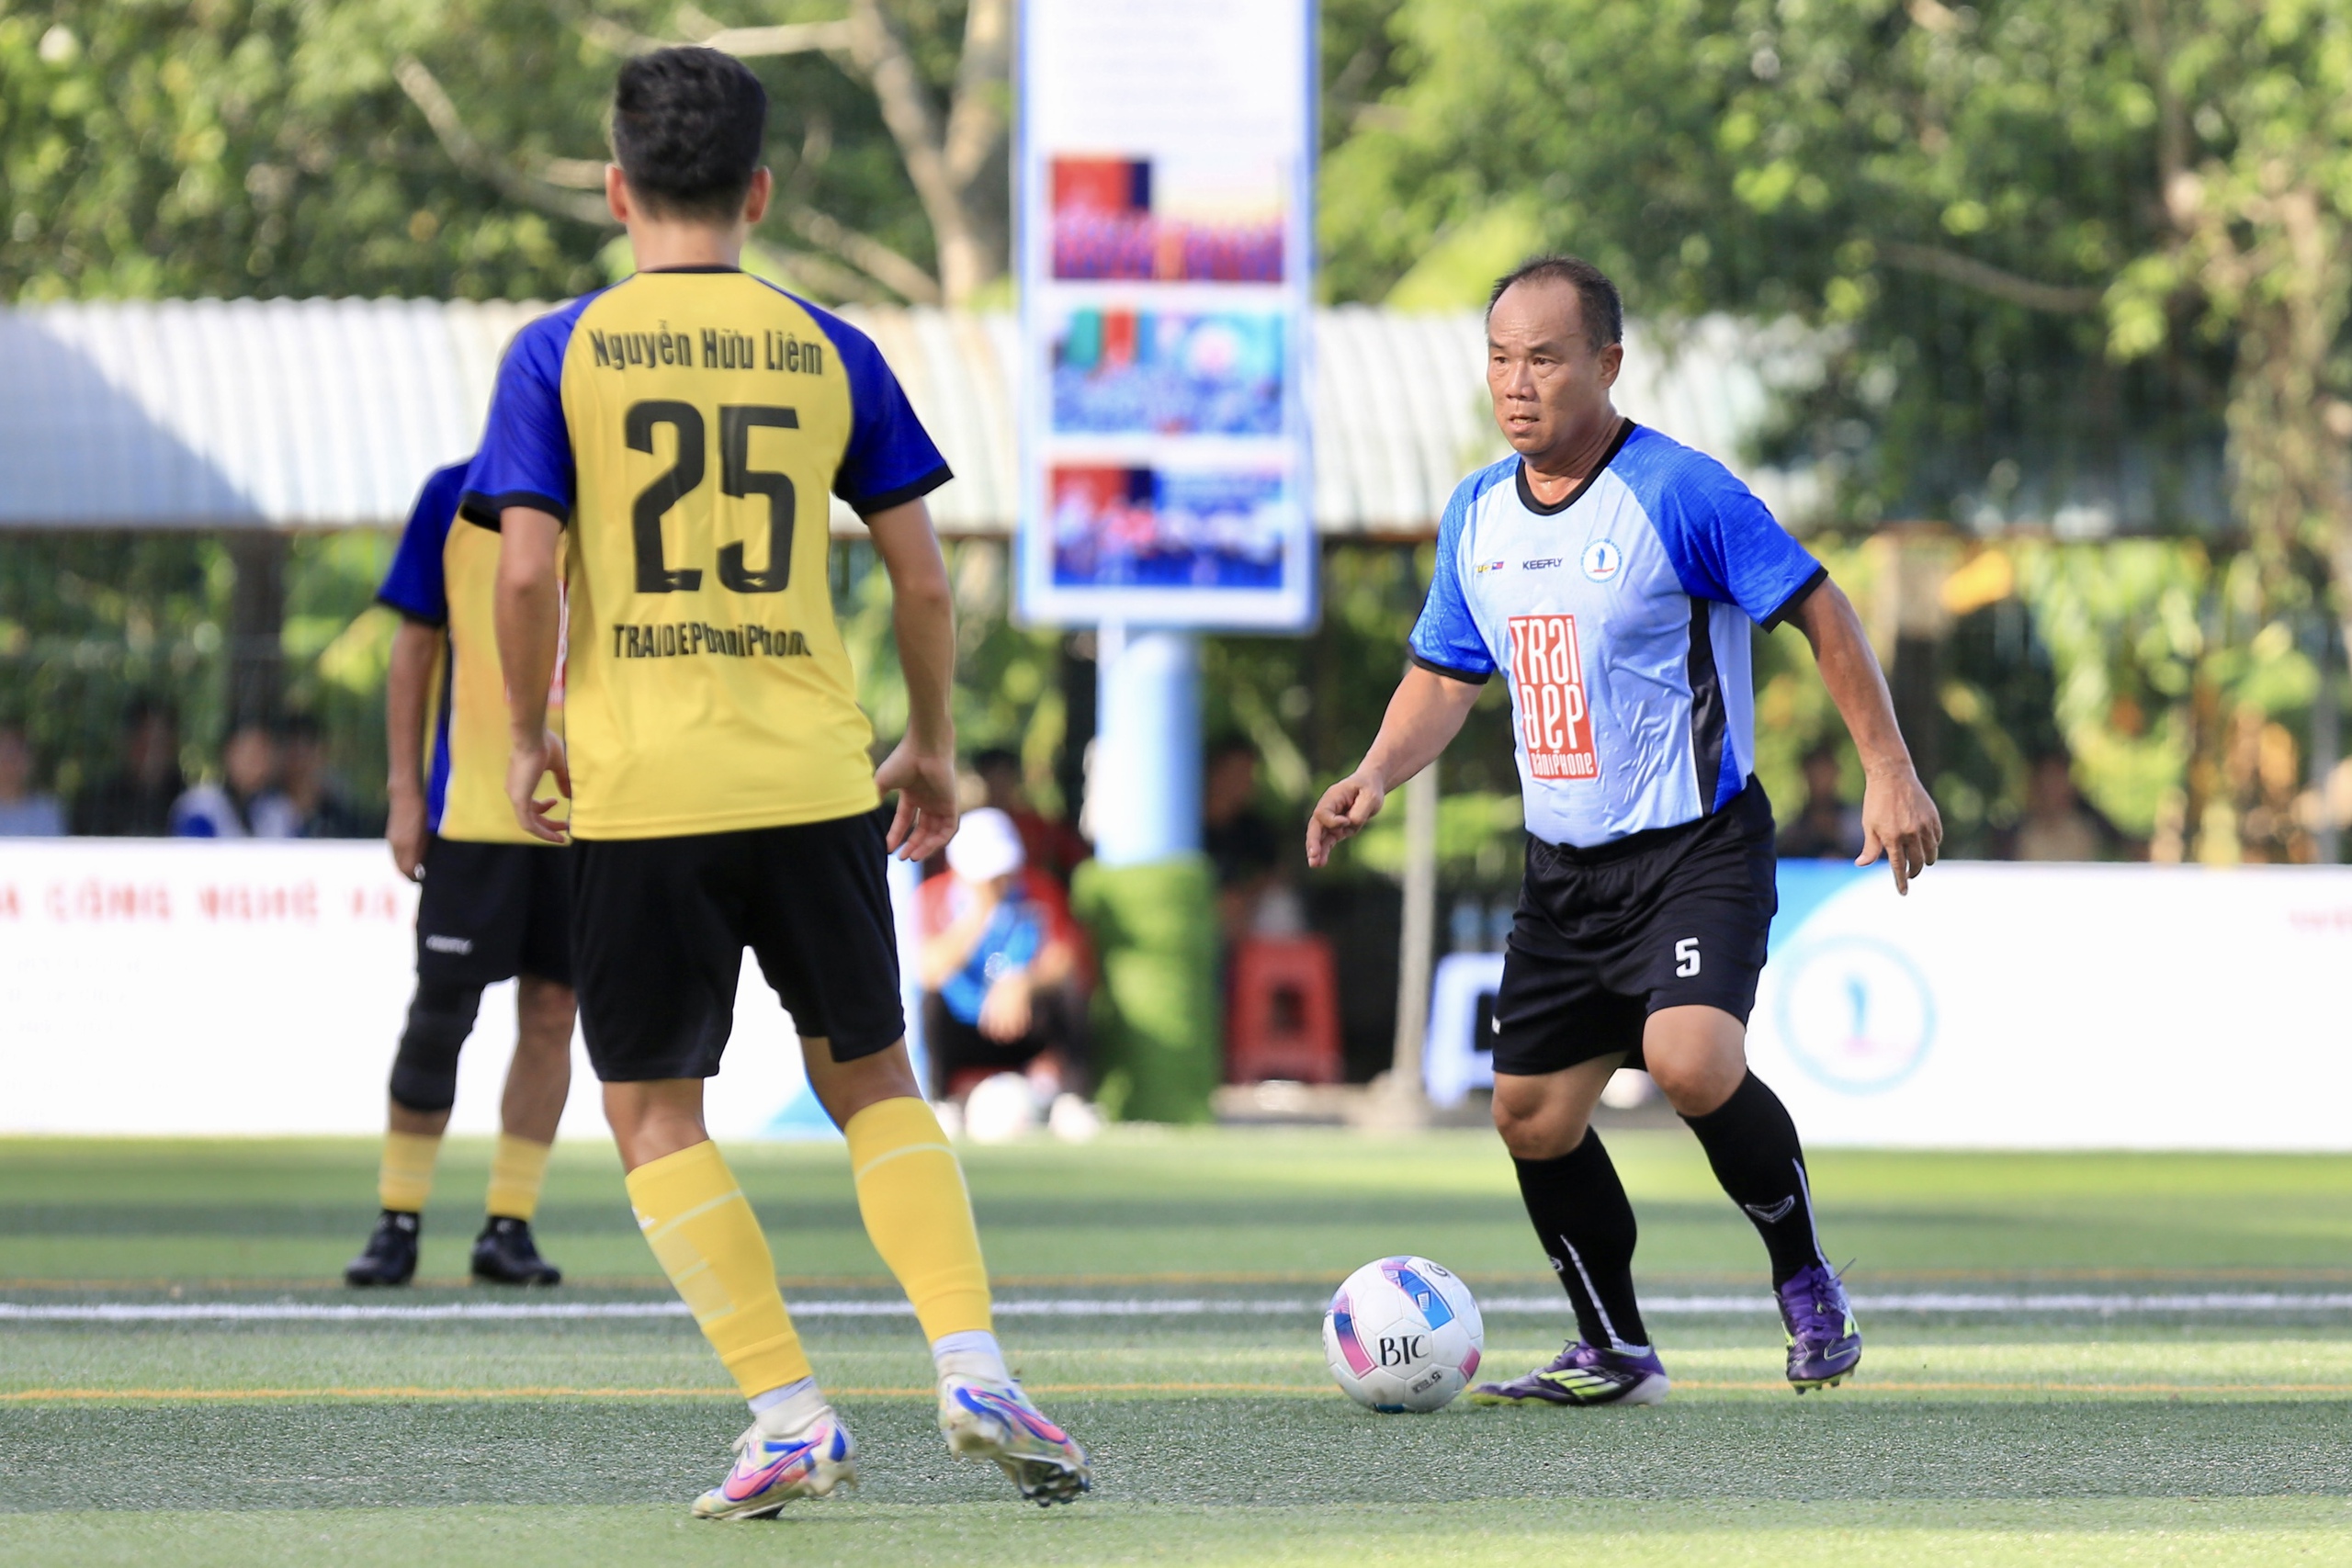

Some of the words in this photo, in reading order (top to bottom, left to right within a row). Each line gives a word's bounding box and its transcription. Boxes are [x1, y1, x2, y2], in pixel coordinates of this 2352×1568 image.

[588, 320, 692, 371] Nguyễn
[700, 328, 753, 369] Hữu
[764, 330, 822, 375] Liêm
[624, 398, 800, 594] 25
[1521, 557, 1564, 570] KEEPFLY
[1674, 936, 1702, 978] 5
[1379, 1334, 1430, 1367] BTC
